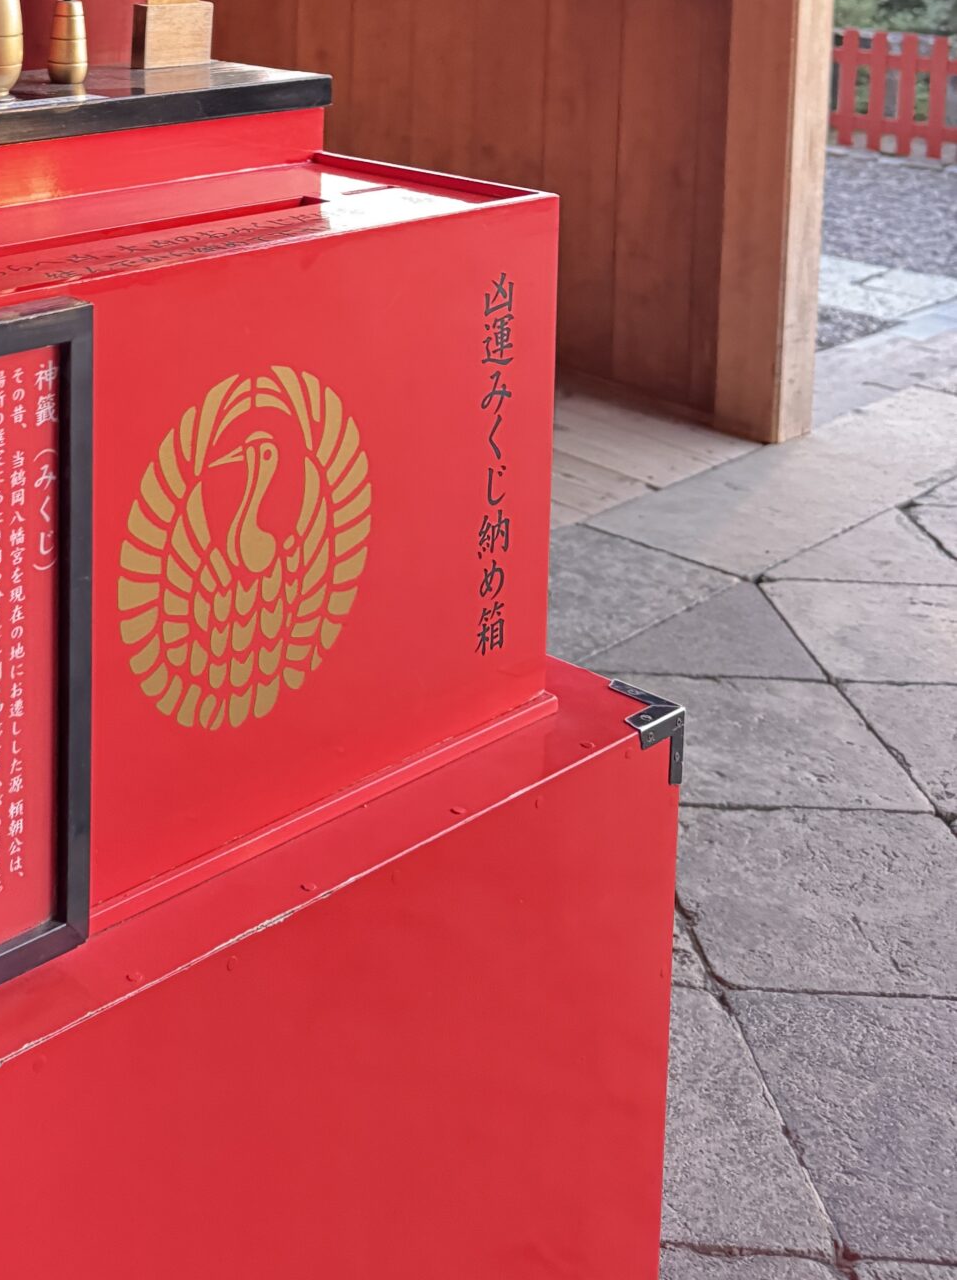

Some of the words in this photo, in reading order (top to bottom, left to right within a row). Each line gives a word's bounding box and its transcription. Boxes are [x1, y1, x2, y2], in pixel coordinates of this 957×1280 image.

[474, 272, 514, 656] 凶運みくじ納め箱
